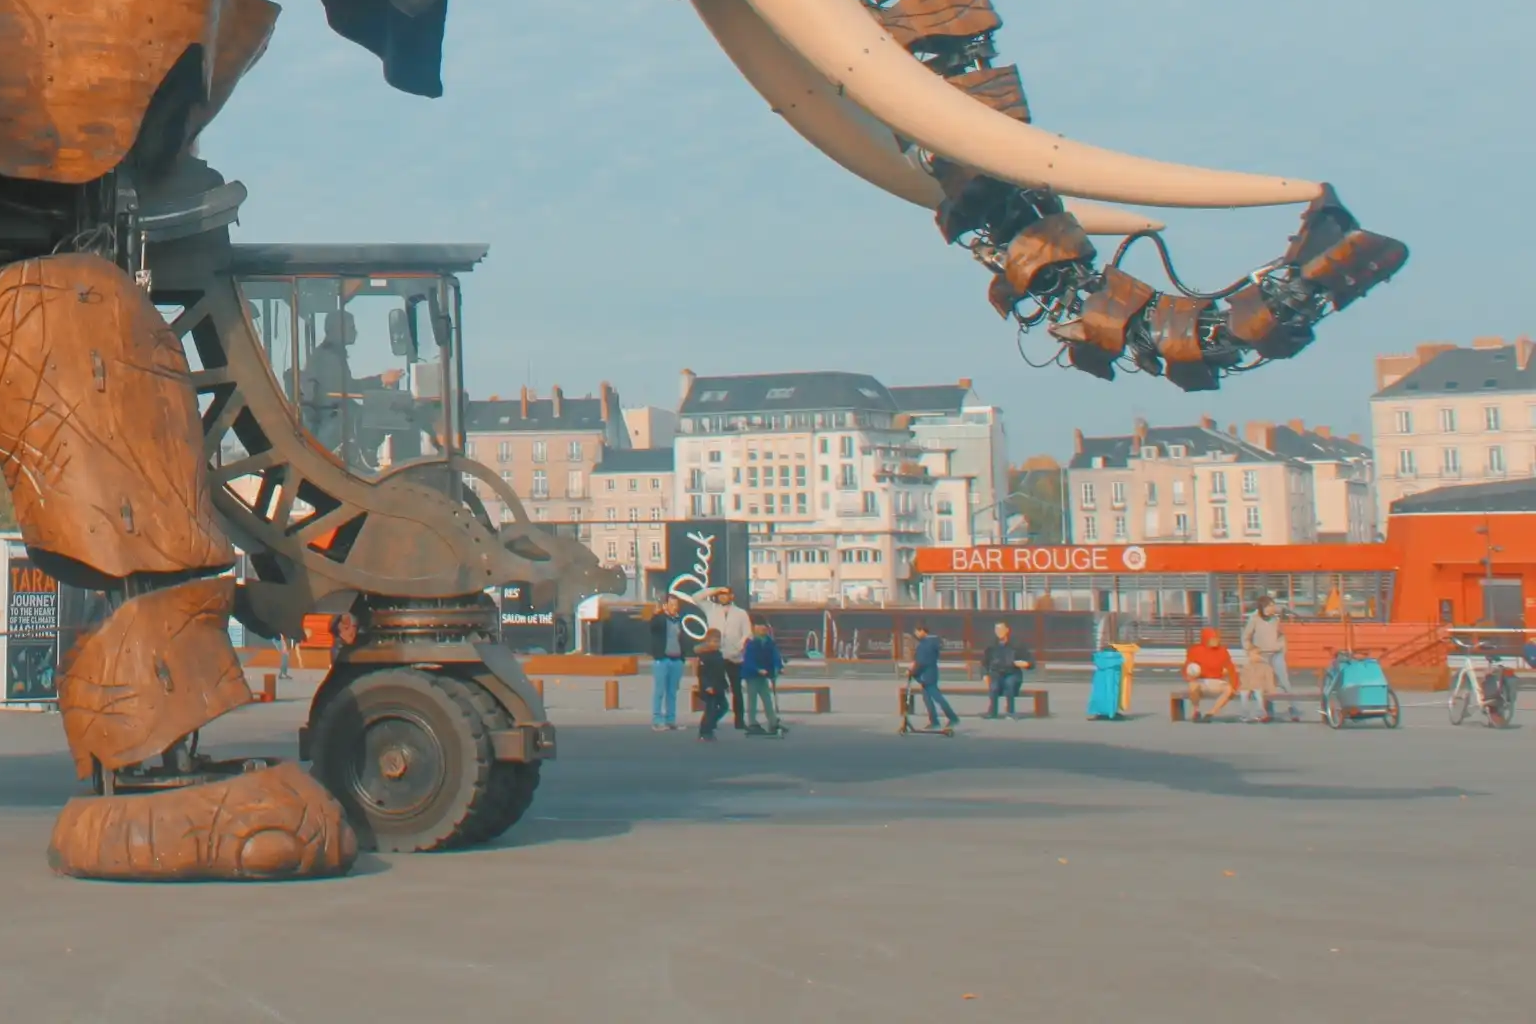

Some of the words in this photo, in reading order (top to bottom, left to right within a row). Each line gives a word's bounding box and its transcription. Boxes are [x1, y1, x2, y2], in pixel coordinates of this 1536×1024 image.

[952, 548, 1003, 571] BAR
[1013, 547, 1109, 571] ROUGE
[11, 567, 57, 592] TARA
[10, 594, 56, 607] JOURNEY
[10, 607, 19, 616] TO
[20, 607, 33, 616] THE
[33, 607, 56, 616] HEART
[538, 611, 554, 625] THÉ
[9, 616, 18, 624] OF
[18, 616, 30, 624] THE
[30, 616, 56, 624] CLIMATE
